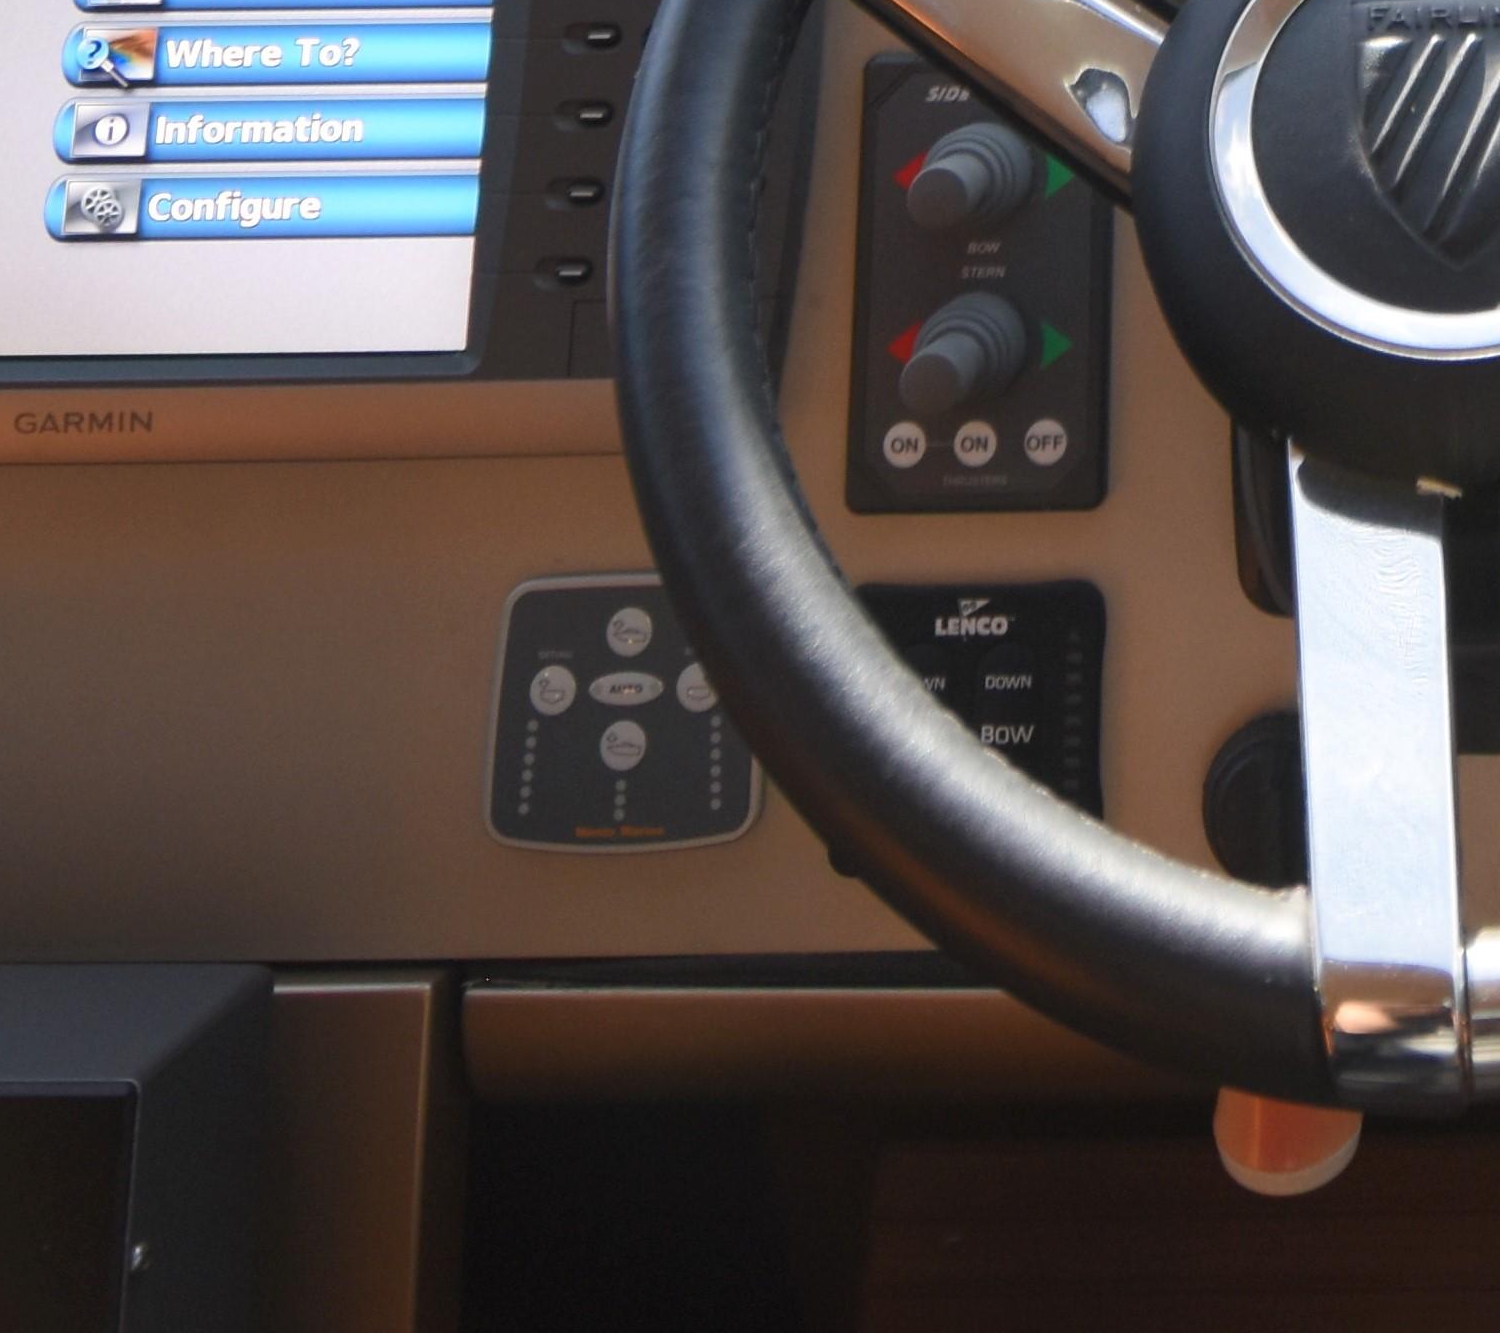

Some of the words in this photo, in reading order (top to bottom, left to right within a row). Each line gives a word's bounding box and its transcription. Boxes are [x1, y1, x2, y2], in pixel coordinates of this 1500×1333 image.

[166, 38, 283, 68] Where
[295, 36, 360, 68] To?
[154, 113, 364, 145] Information
[147, 190, 322, 228] Configure
[967, 242, 1001, 255] BOW
[960, 265, 1005, 279] STERN
[13, 411, 154, 434] GARMIN
[890, 438, 918, 453] ON
[960, 436, 988, 452] ON
[1026, 435, 1065, 451] OFF
[934, 617, 1009, 636] LENCO
[984, 674, 1033, 690] DOWN
[980, 725, 1035, 745] BOW
